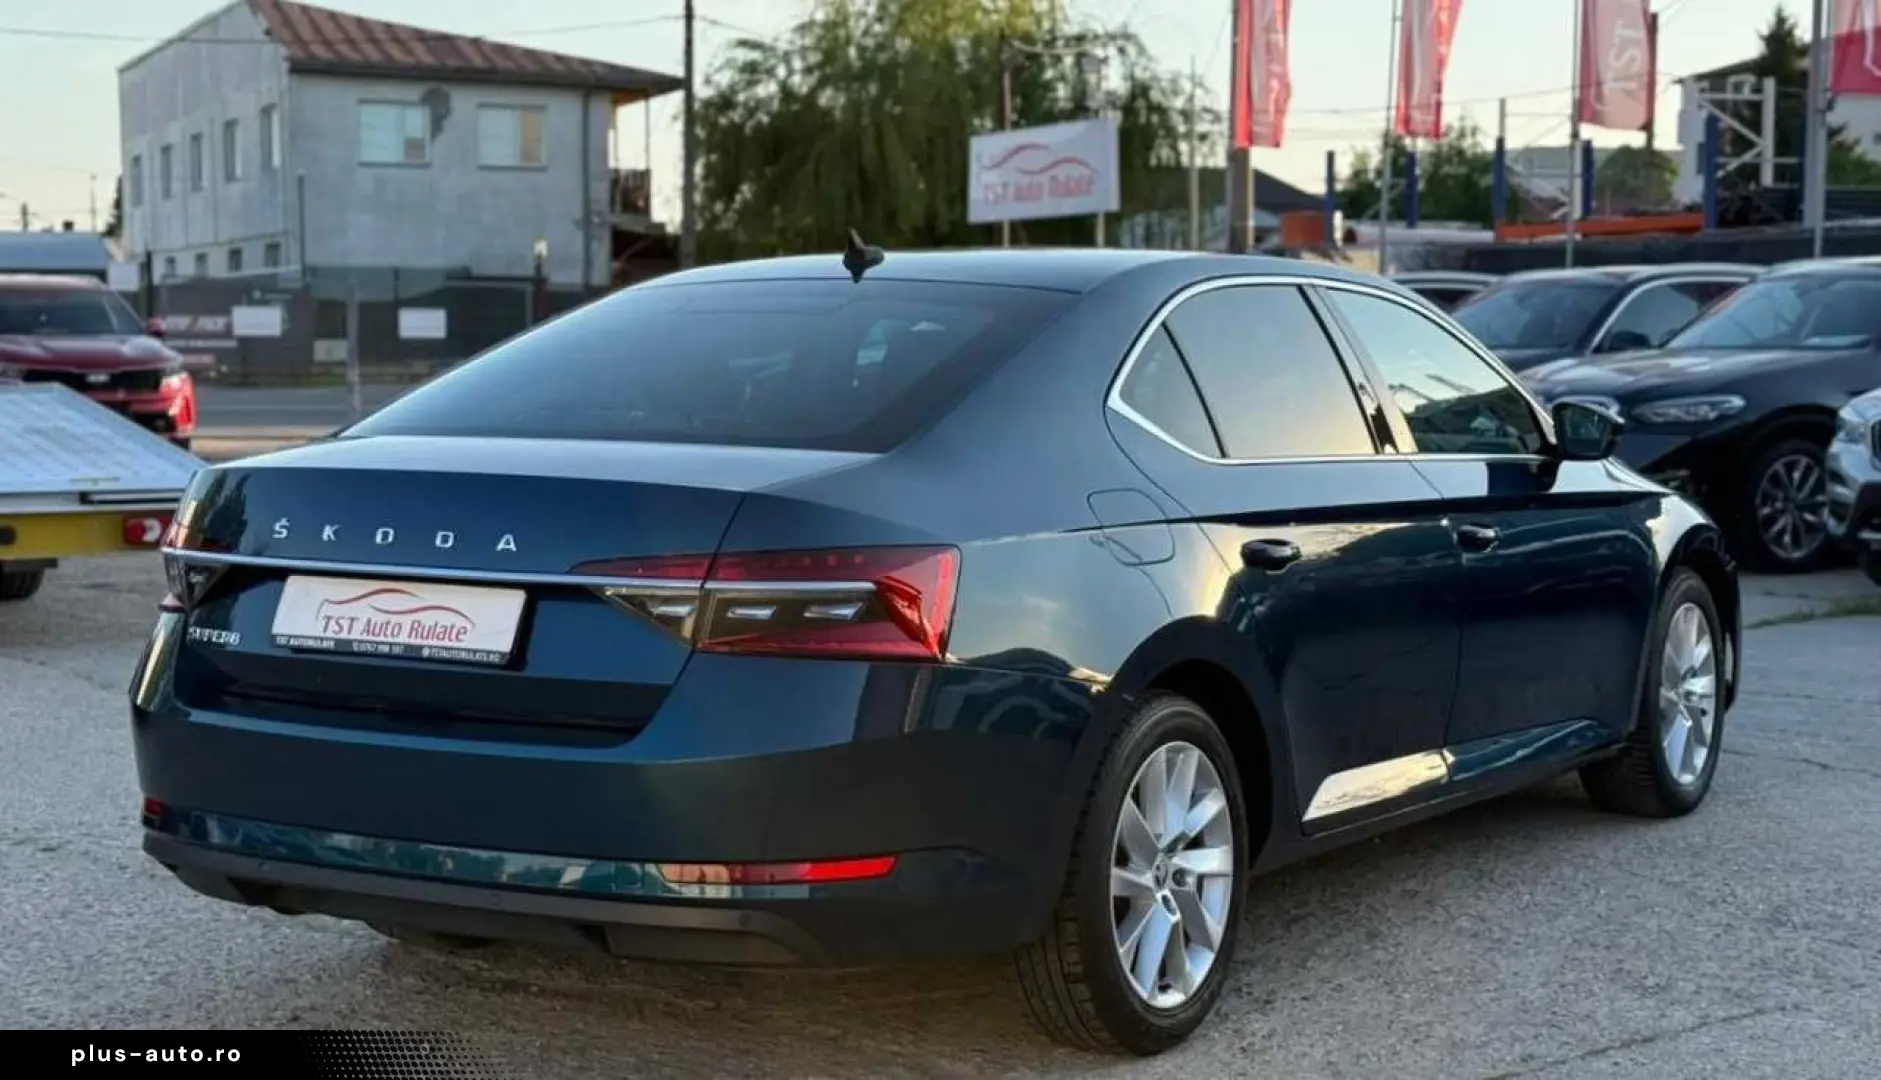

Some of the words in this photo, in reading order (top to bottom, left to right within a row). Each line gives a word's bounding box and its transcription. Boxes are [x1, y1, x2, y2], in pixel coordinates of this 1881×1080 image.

[272, 517, 517, 552] ŠKODA
[322, 615, 360, 634] TST
[360, 616, 402, 638] Auto
[407, 619, 469, 642] Rulate
